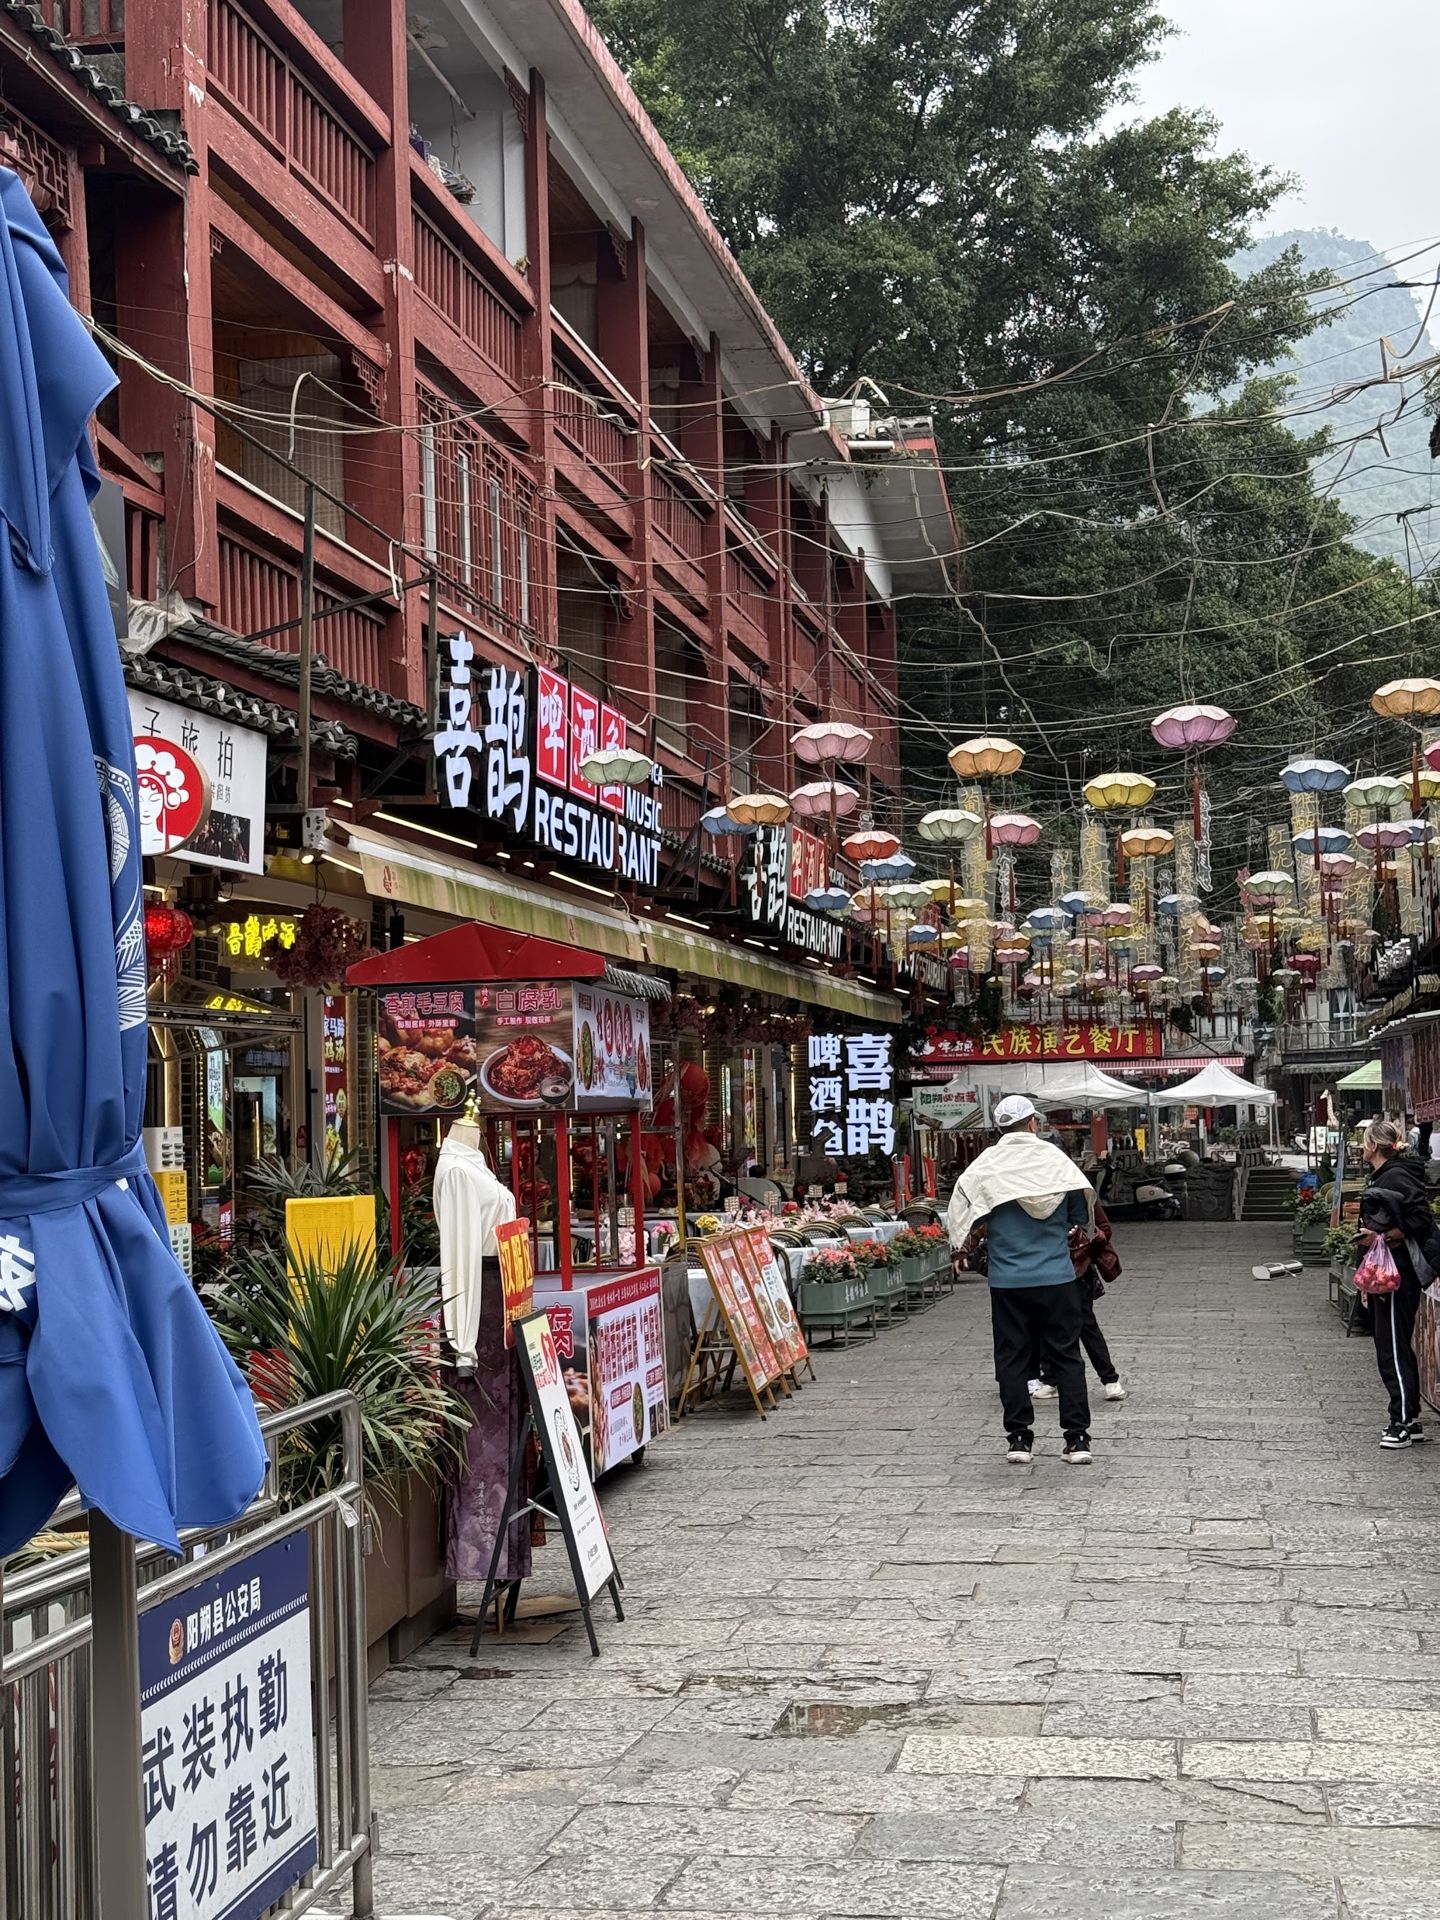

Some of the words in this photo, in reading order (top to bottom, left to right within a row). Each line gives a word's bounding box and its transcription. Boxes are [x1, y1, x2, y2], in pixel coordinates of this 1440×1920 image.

[434, 631, 530, 834] 喜鹊
[535, 787, 661, 888] RESTAURANT
[625, 786, 663, 835] MUSIC
[787, 906, 843, 959] RESTAURANT
[385, 990, 464, 1015] 香煎毛豆腐
[496, 987, 563, 1013] 白腐乳
[982, 1023, 1140, 1056] 民族演艺餐厅
[808, 1034, 843, 1156] 啤酒鱼
[845, 1033, 895, 1156] 喜鹊
[186, 1576, 262, 1654] 阳朔县公安局
[143, 1648, 289, 1824] 武装执勤
[146, 1752, 292, 1920] 请勿靠近
